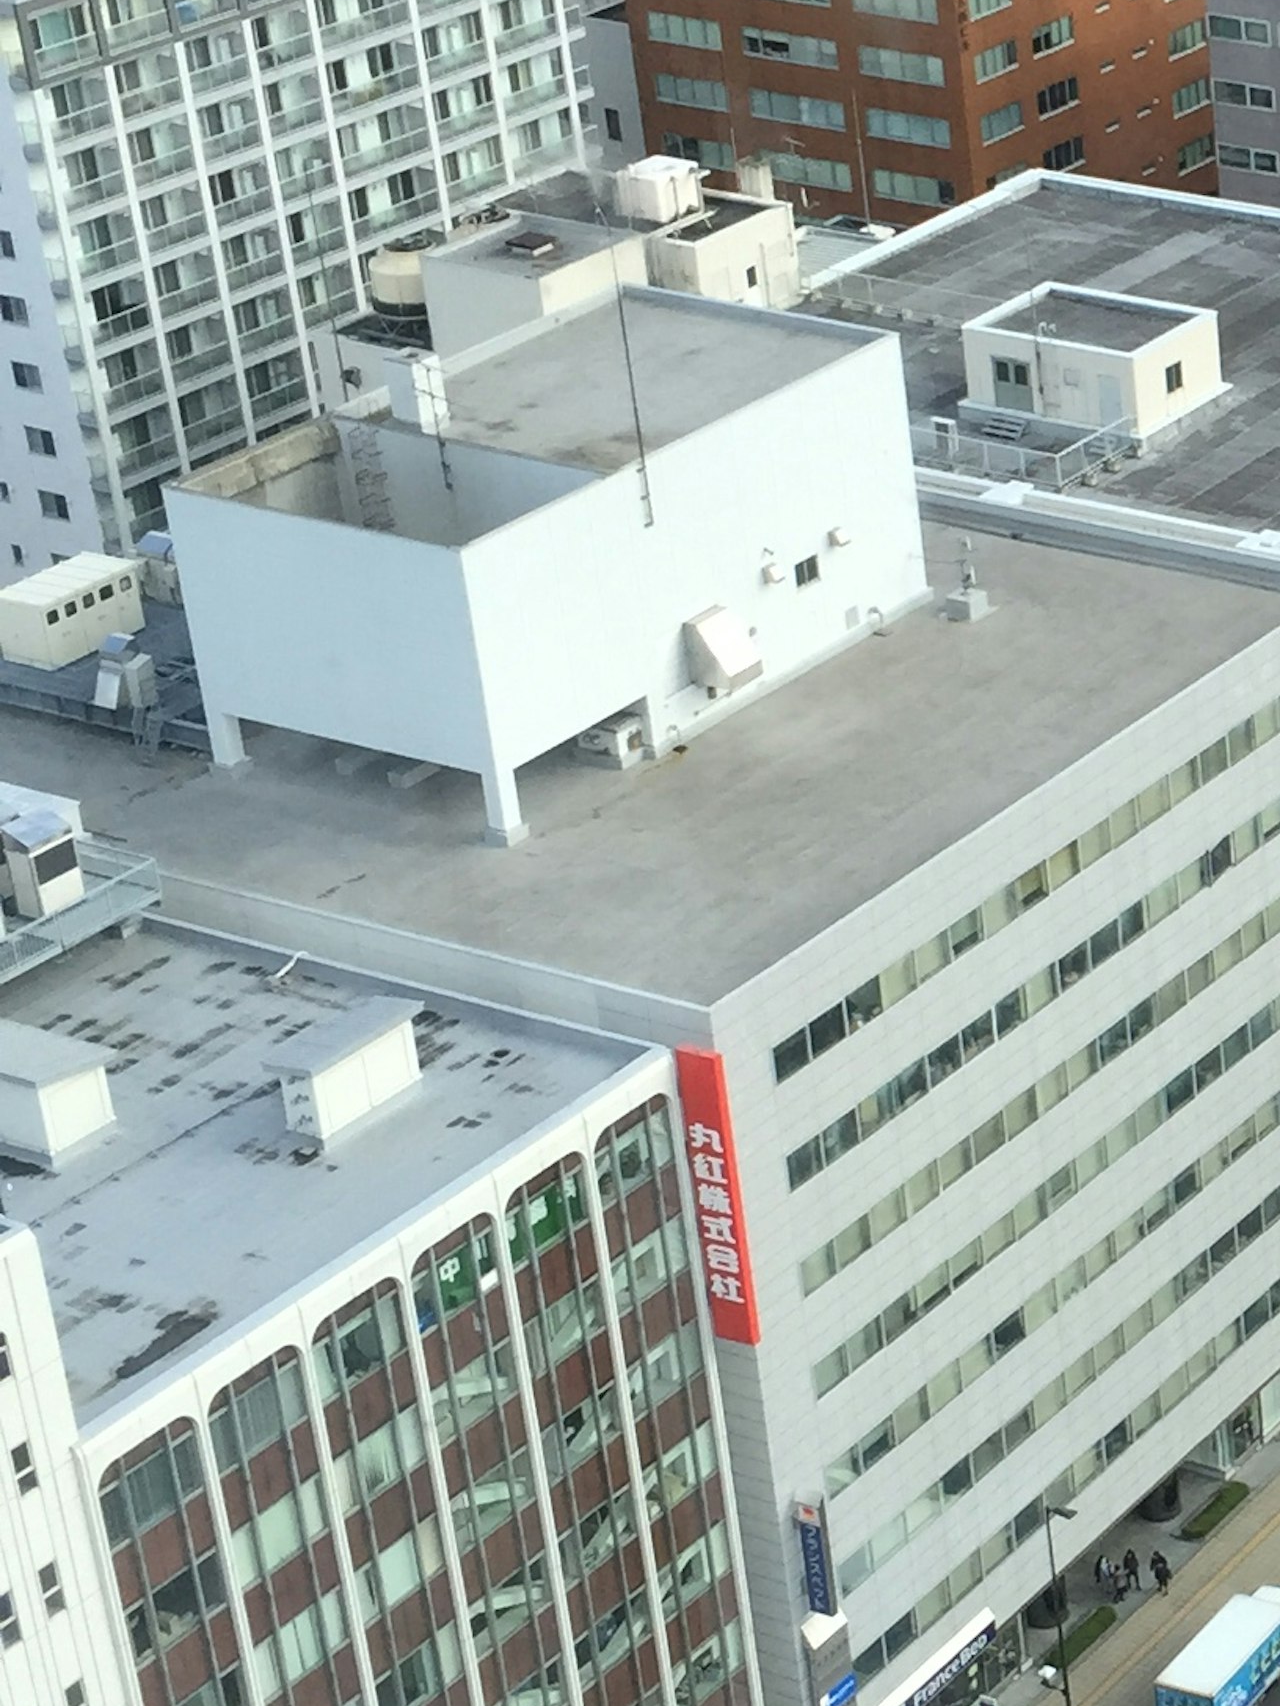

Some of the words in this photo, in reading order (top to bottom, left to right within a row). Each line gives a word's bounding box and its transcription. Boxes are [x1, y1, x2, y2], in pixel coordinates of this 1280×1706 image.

[689, 1122, 745, 1304] 丸紅株式会社
